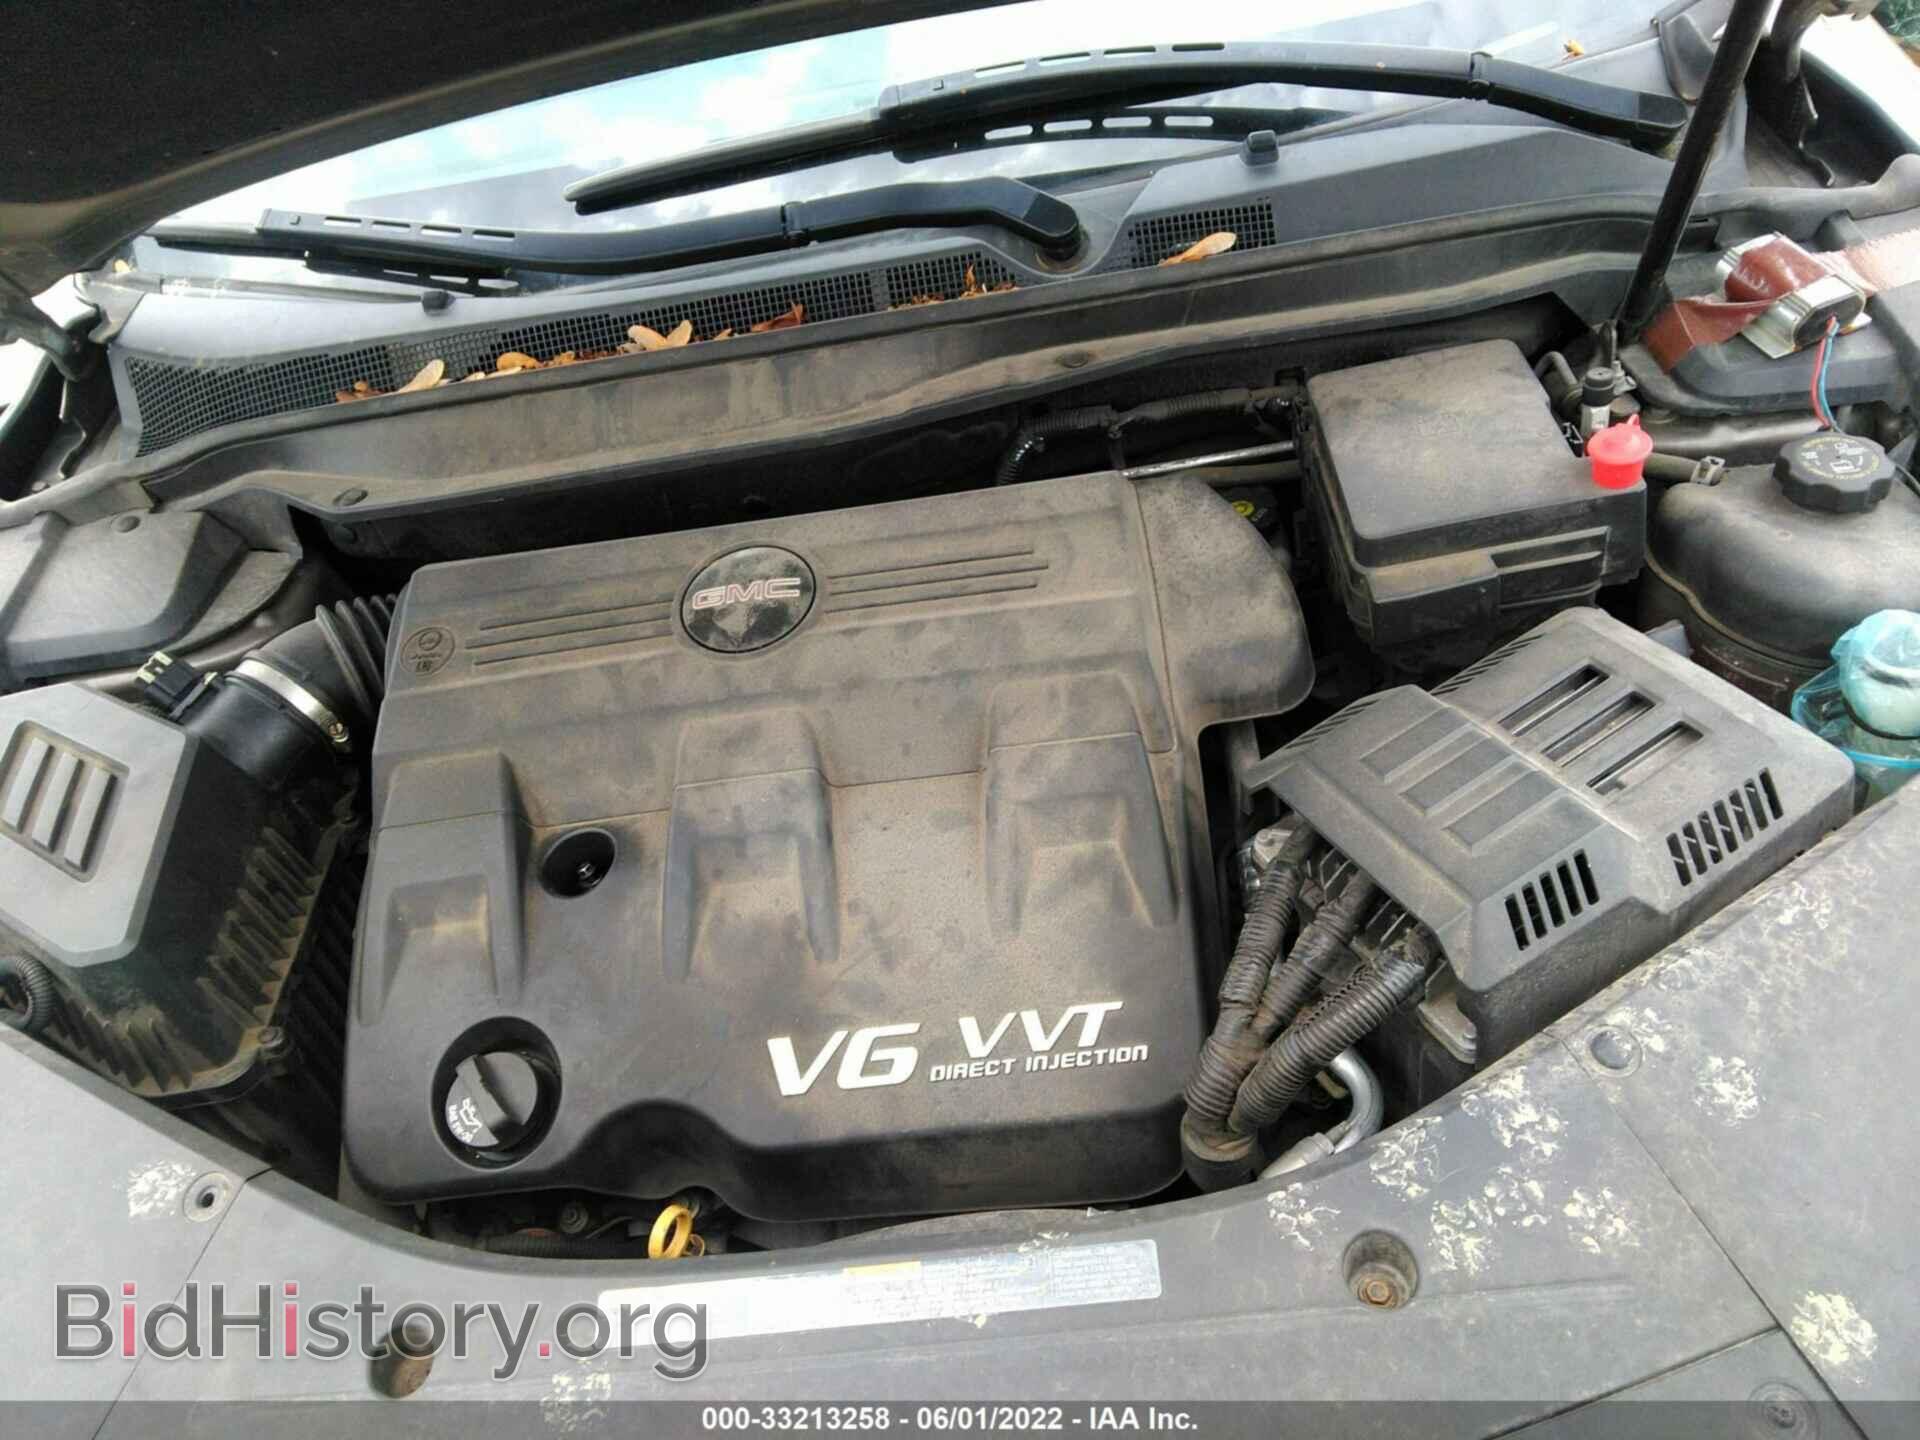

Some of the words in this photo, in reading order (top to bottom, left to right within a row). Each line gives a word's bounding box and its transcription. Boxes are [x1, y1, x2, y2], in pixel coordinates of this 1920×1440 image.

[692, 577, 801, 610] GMC
[767, 1022, 921, 1096] V6
[959, 1001, 1124, 1058] VVT
[930, 1058, 1016, 1081] DIRECT
[1025, 1045, 1149, 1072] INJECTION
